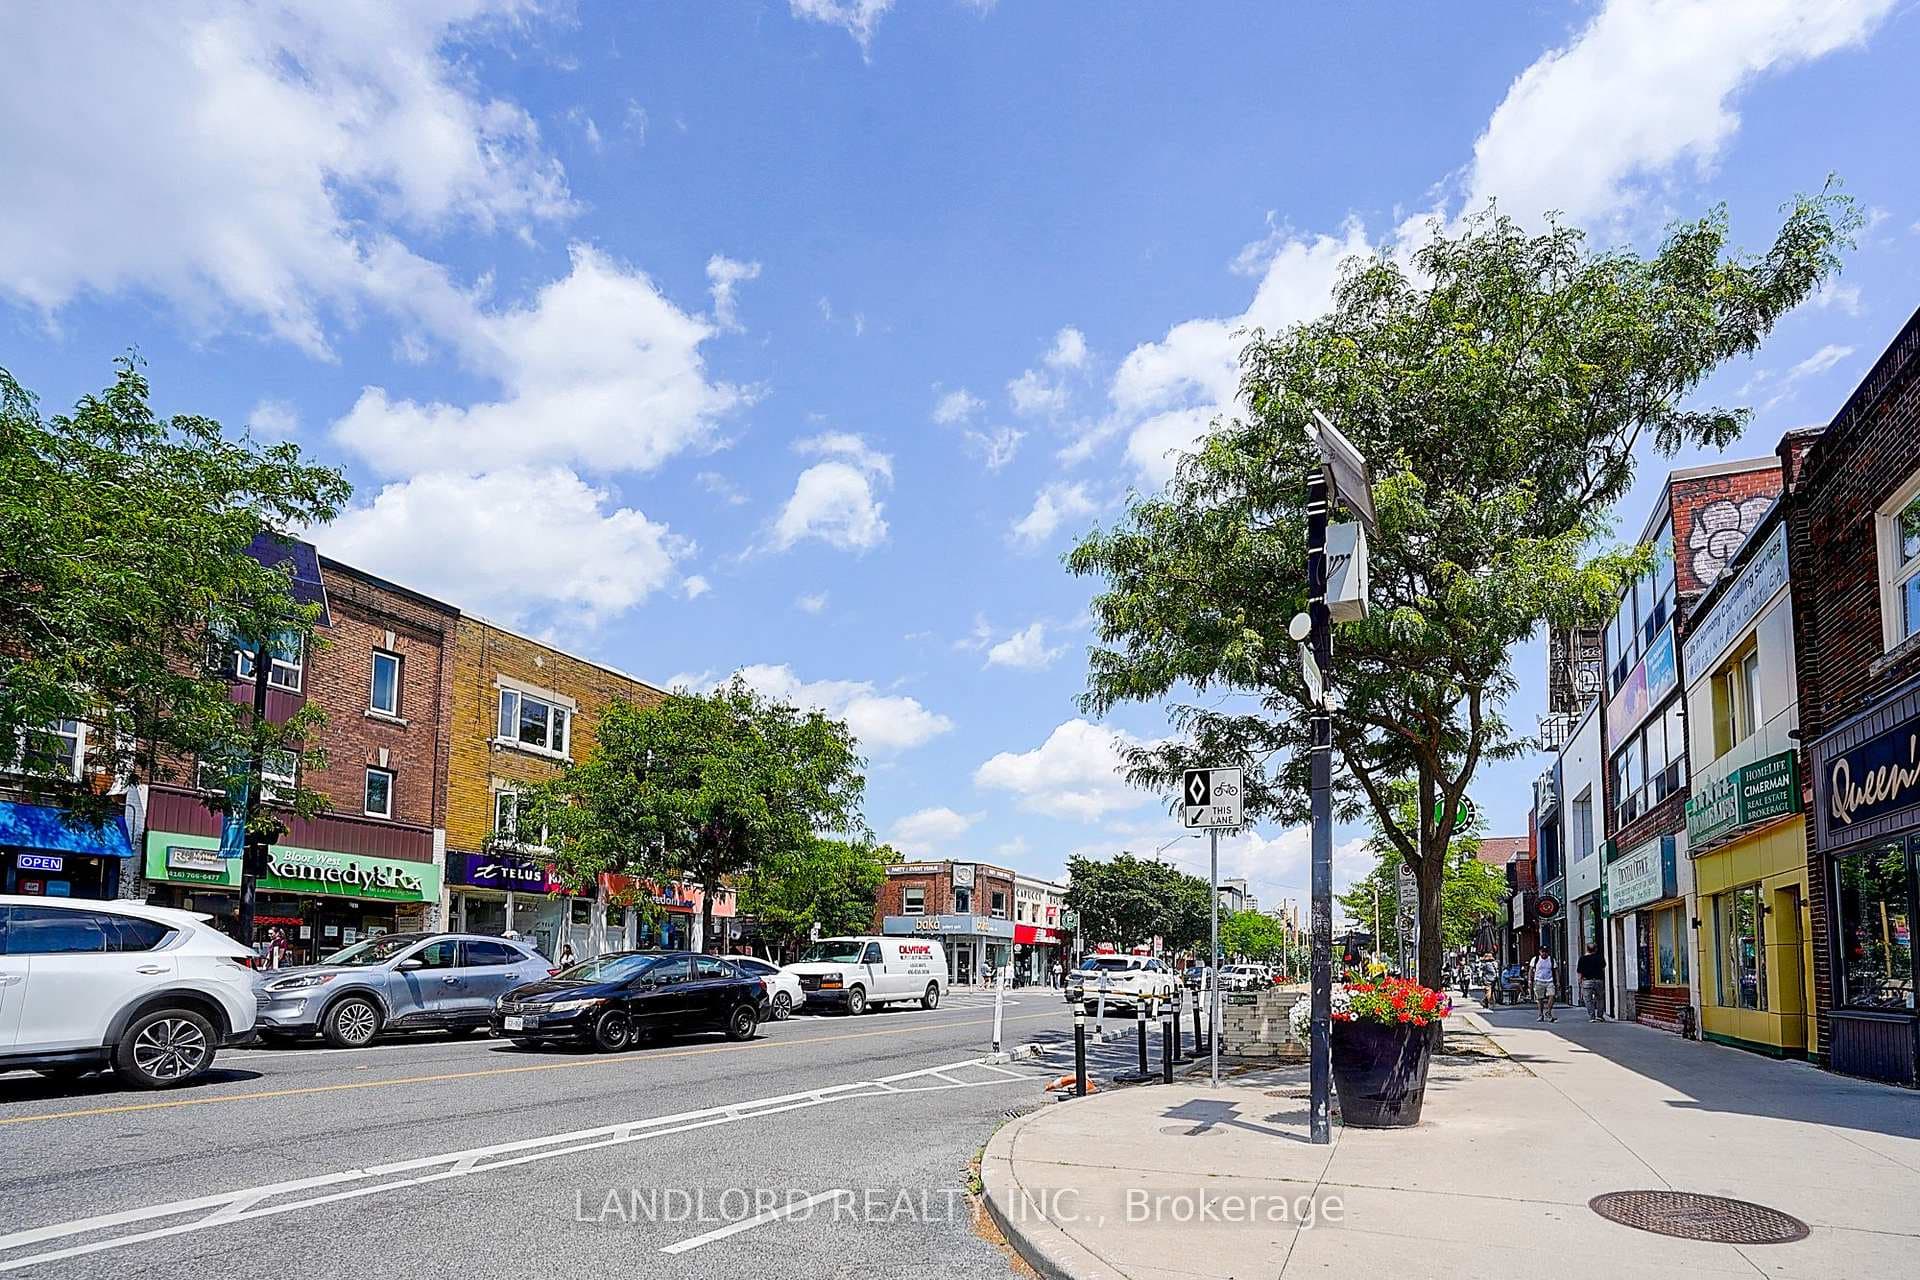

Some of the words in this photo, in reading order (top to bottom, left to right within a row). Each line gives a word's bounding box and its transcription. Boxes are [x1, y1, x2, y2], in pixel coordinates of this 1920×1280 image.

[1754, 538, 1782, 580] Services
[1745, 760, 1787, 782] HOMELIFE
[1832, 734, 1920, 824] Queen'
[1744, 774, 1790, 798] CIMERMAN
[1747, 797, 1763, 809] REAL
[1764, 791, 1788, 805] ESTATE
[1212, 806, 1232, 815] THIS
[1747, 802, 1789, 820] BROKERAGE
[1210, 815, 1233, 825] LANE
[21, 857, 60, 869] OPEN
[283, 851, 313, 863] Bloor
[316, 854, 341, 866] West
[501, 867, 541, 882] TELUS
[898, 944, 931, 954] OLYMPIC
